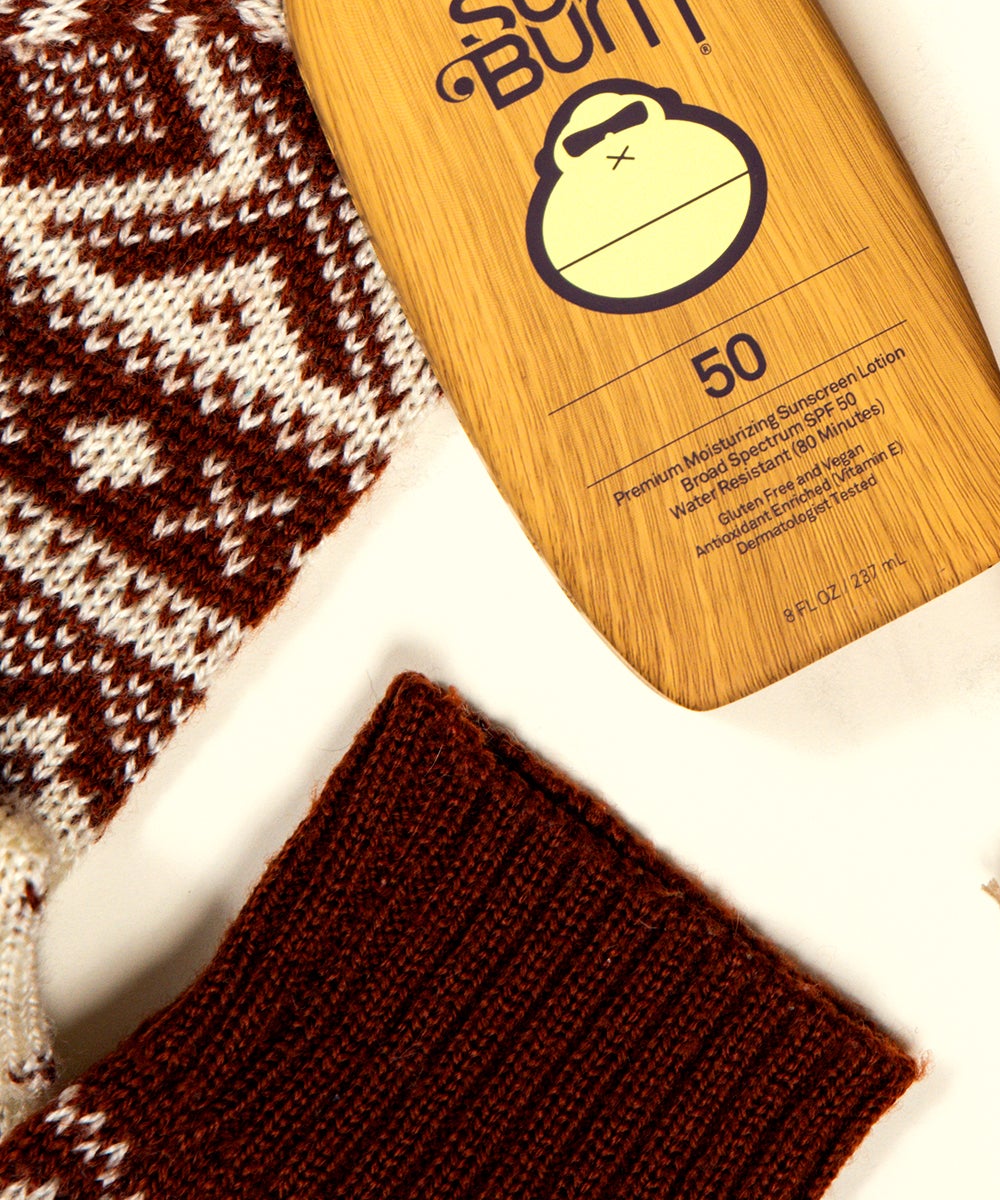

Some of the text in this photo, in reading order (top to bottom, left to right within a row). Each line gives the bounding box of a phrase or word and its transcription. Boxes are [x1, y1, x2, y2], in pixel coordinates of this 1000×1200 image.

[691, 333, 767, 398] 50
[612, 346, 906, 507] Premium Moisturizing Sunscreen Lotion
[669, 396, 887, 521] Water Resistant (80 Minutes)
[680, 390, 858, 493] Broad Spectrum SPF 50
[693, 439, 905, 558] Antioxidant Enriched (Vitamin E)
[717, 443, 865, 526] Gluten Free and Vegan
[735, 472, 878, 555] Dermatologist Tested
[782, 607, 796, 623] 8
[794, 596, 817, 617] FL
[815, 583, 841, 606] OZ
[848, 563, 880, 589] 237
[879, 550, 907, 572] mL
